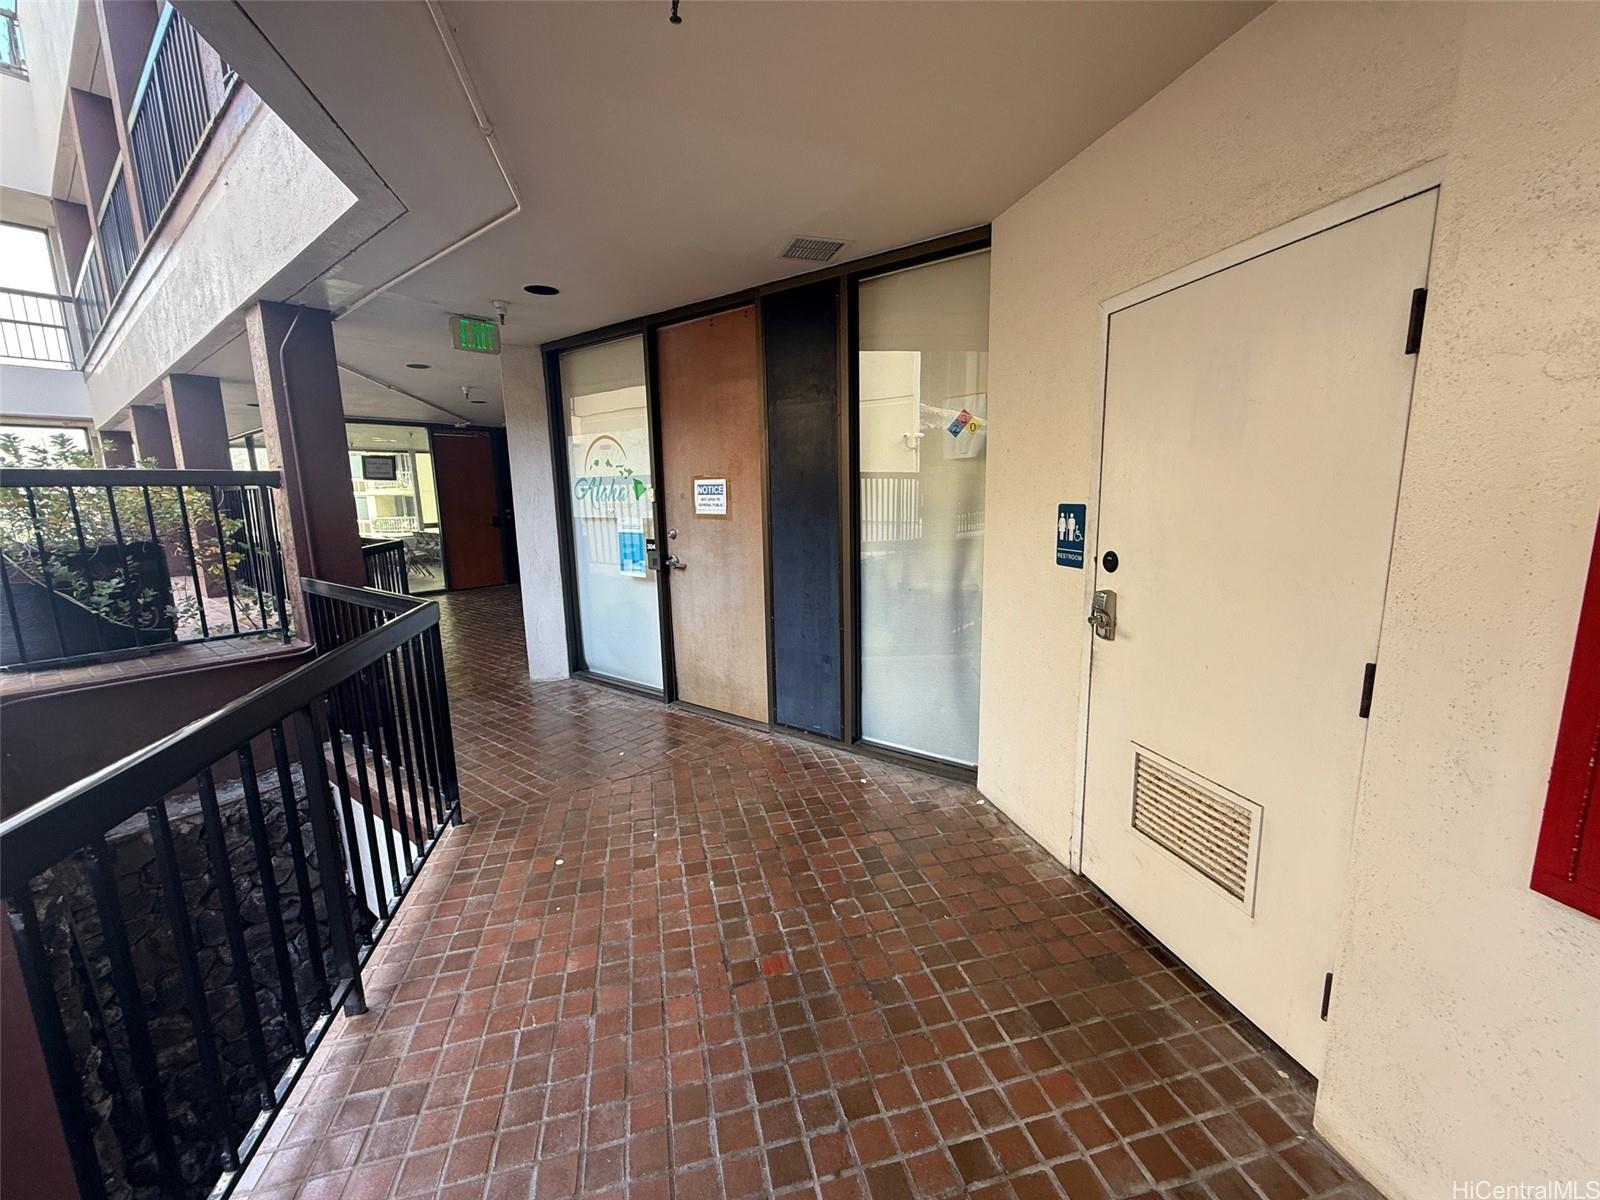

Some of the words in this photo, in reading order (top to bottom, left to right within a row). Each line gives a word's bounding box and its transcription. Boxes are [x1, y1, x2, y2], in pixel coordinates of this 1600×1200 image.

[460, 319, 494, 352] EXIT
[574, 476, 627, 511] Aloha
[697, 486, 723, 494] NOTICE
[1057, 553, 1082, 561] RESTROOM
